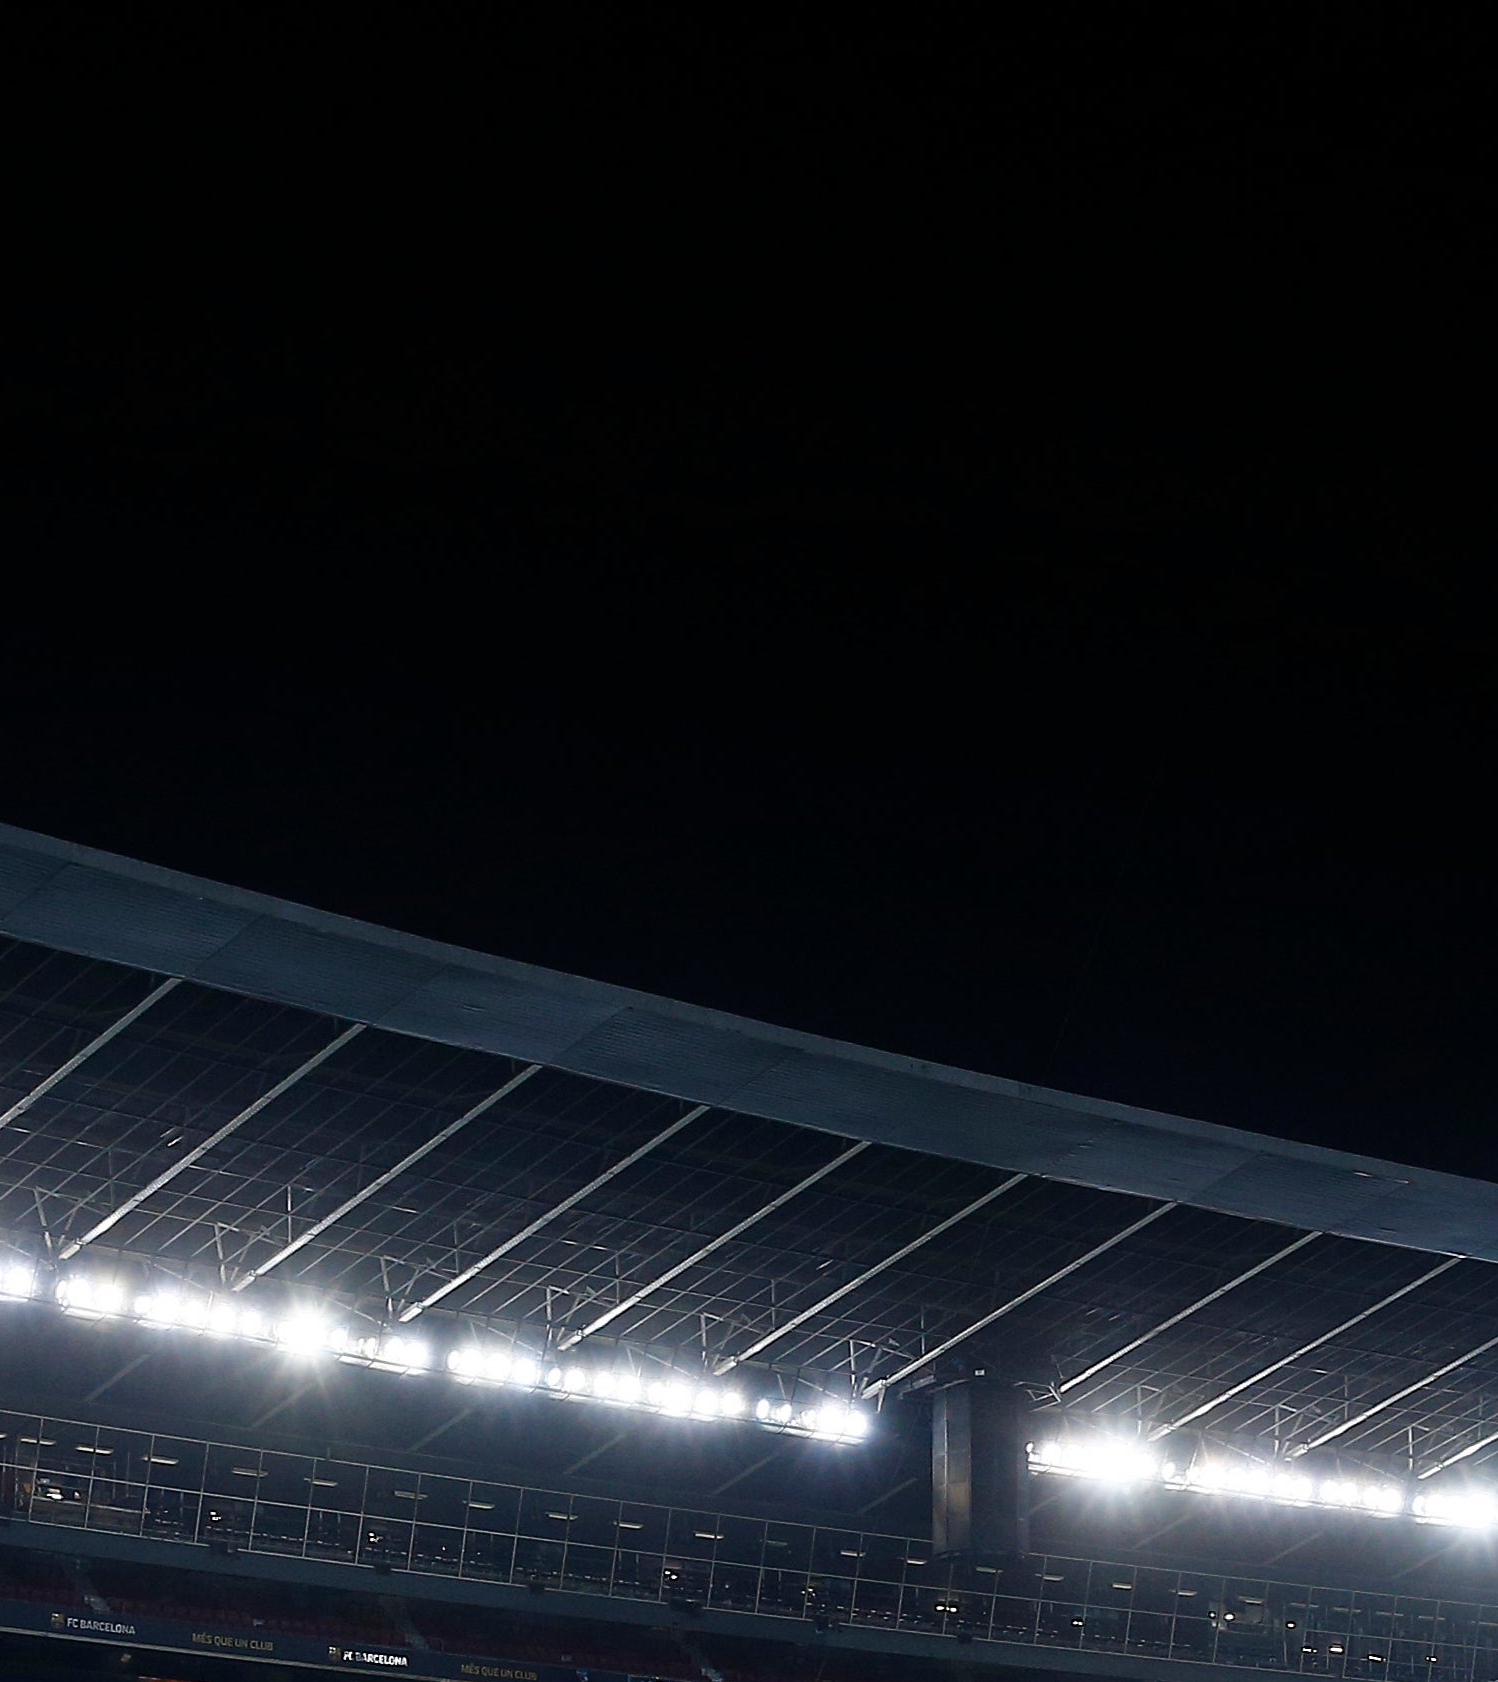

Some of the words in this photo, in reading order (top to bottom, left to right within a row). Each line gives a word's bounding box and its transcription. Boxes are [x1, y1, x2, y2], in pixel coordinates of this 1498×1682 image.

[67, 1617, 78, 1628] FC
[80, 1619, 135, 1635] BARCELONA
[192, 1633, 212, 1645] MÉS
[214, 1637, 232, 1648] QUE
[235, 1638, 247, 1649] UN
[249, 1640, 273, 1651] CLUB
[461, 1664, 480, 1674] MÉS
[482, 1667, 499, 1677] QUE
[500, 1669, 512, 1679] UN
[514, 1670, 537, 1681] CLUB
